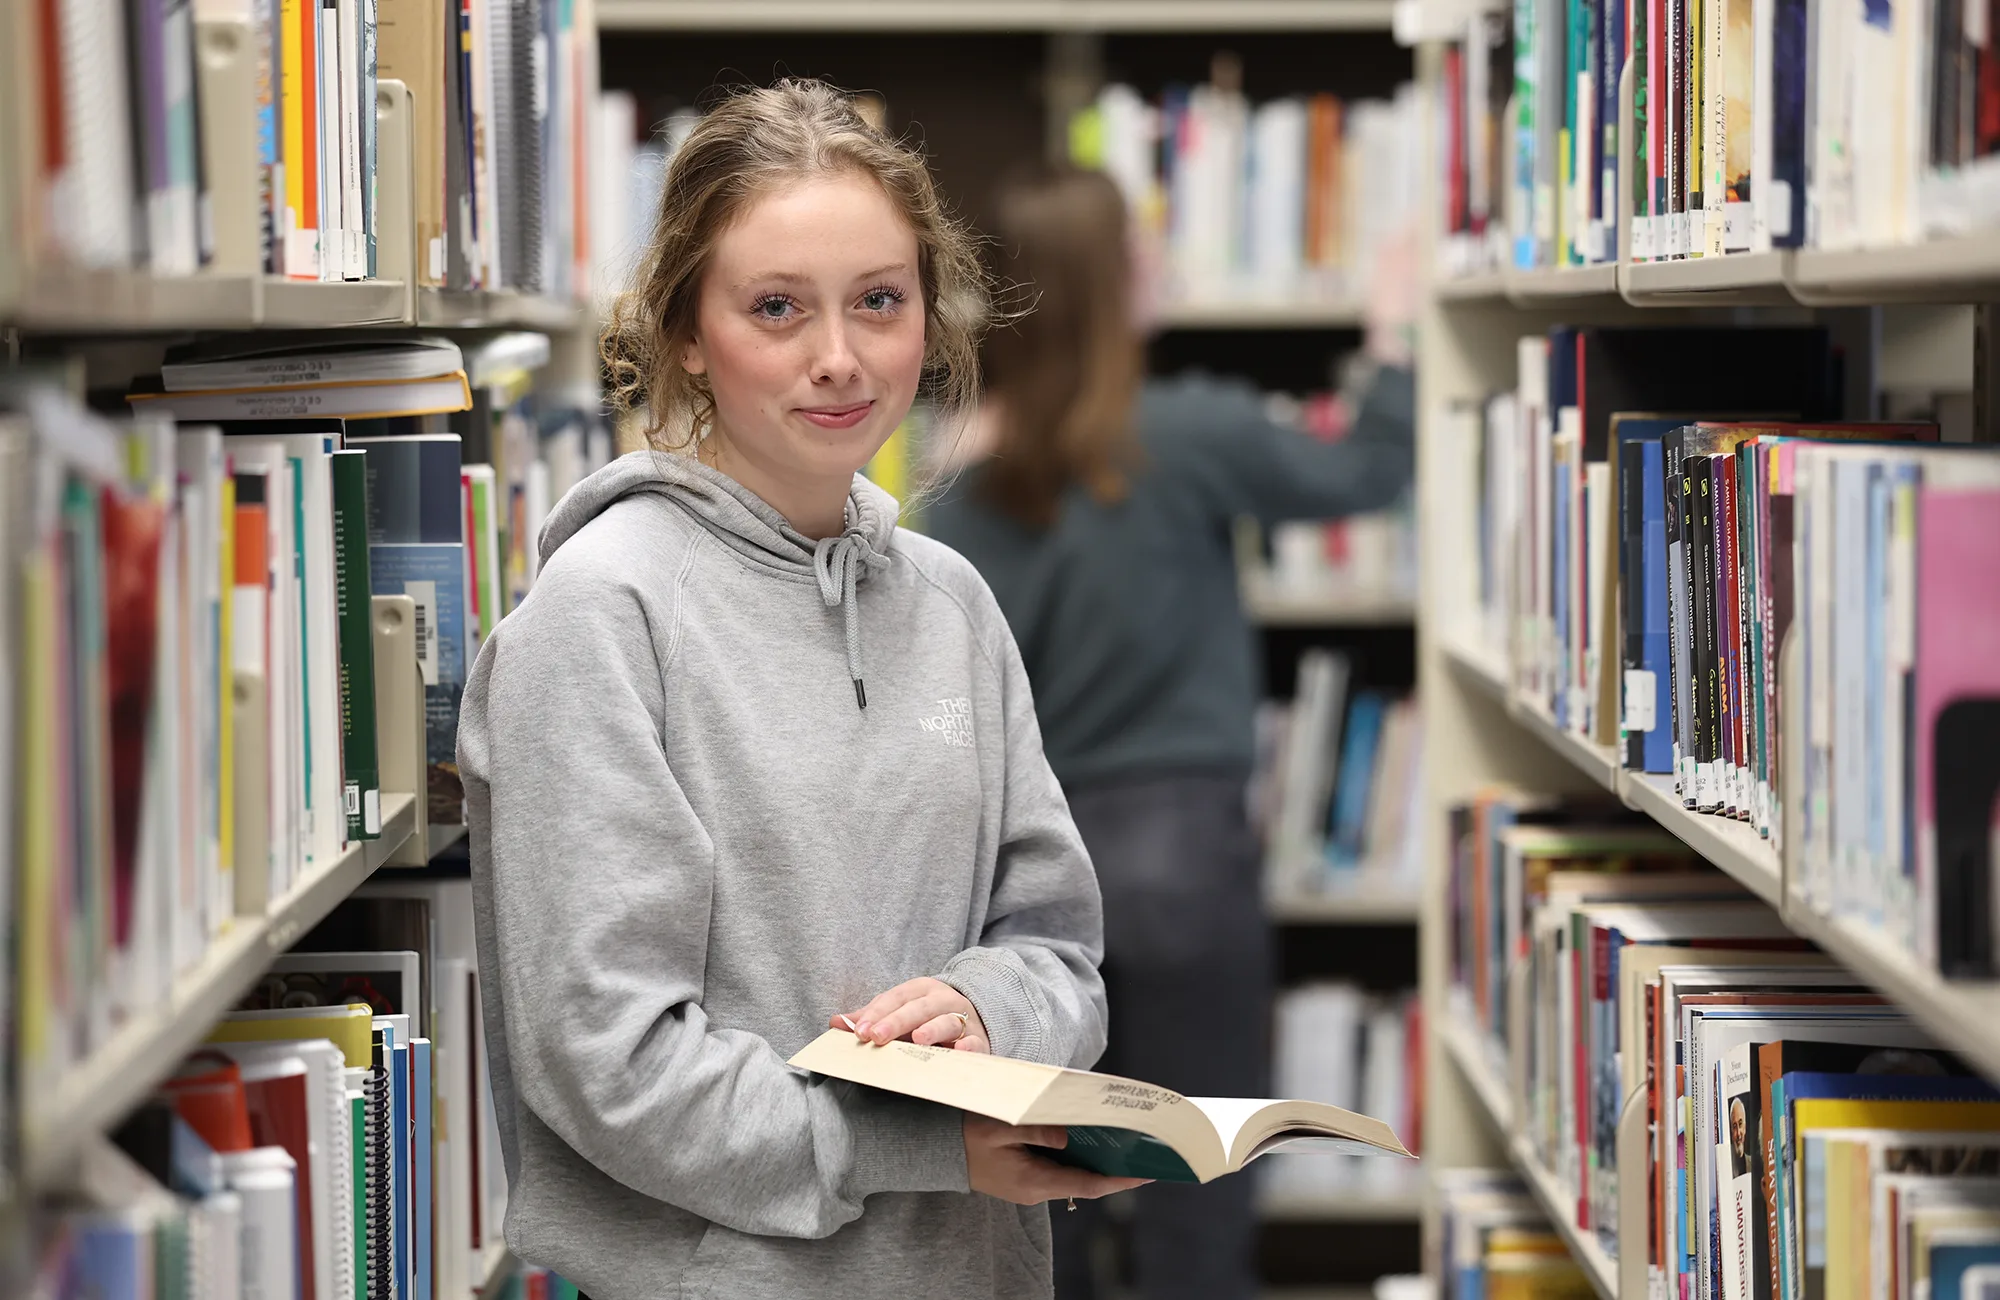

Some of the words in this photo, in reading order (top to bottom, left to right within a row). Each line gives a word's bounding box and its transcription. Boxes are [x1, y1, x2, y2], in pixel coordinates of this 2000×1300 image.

[1714, 518, 1722, 580] CHAMPAGNE
[1687, 585, 1695, 649] Champagne
[937, 697, 970, 714] THE
[1719, 657, 1728, 714] ADAM
[918, 713, 973, 732] NORTH
[943, 730, 976, 749] FACE
[1727, 1072, 1749, 1085] Deschamps
[1767, 1138, 1778, 1290] DESCHAMPS
[1736, 1190, 1746, 1298] DESCHAMPS
